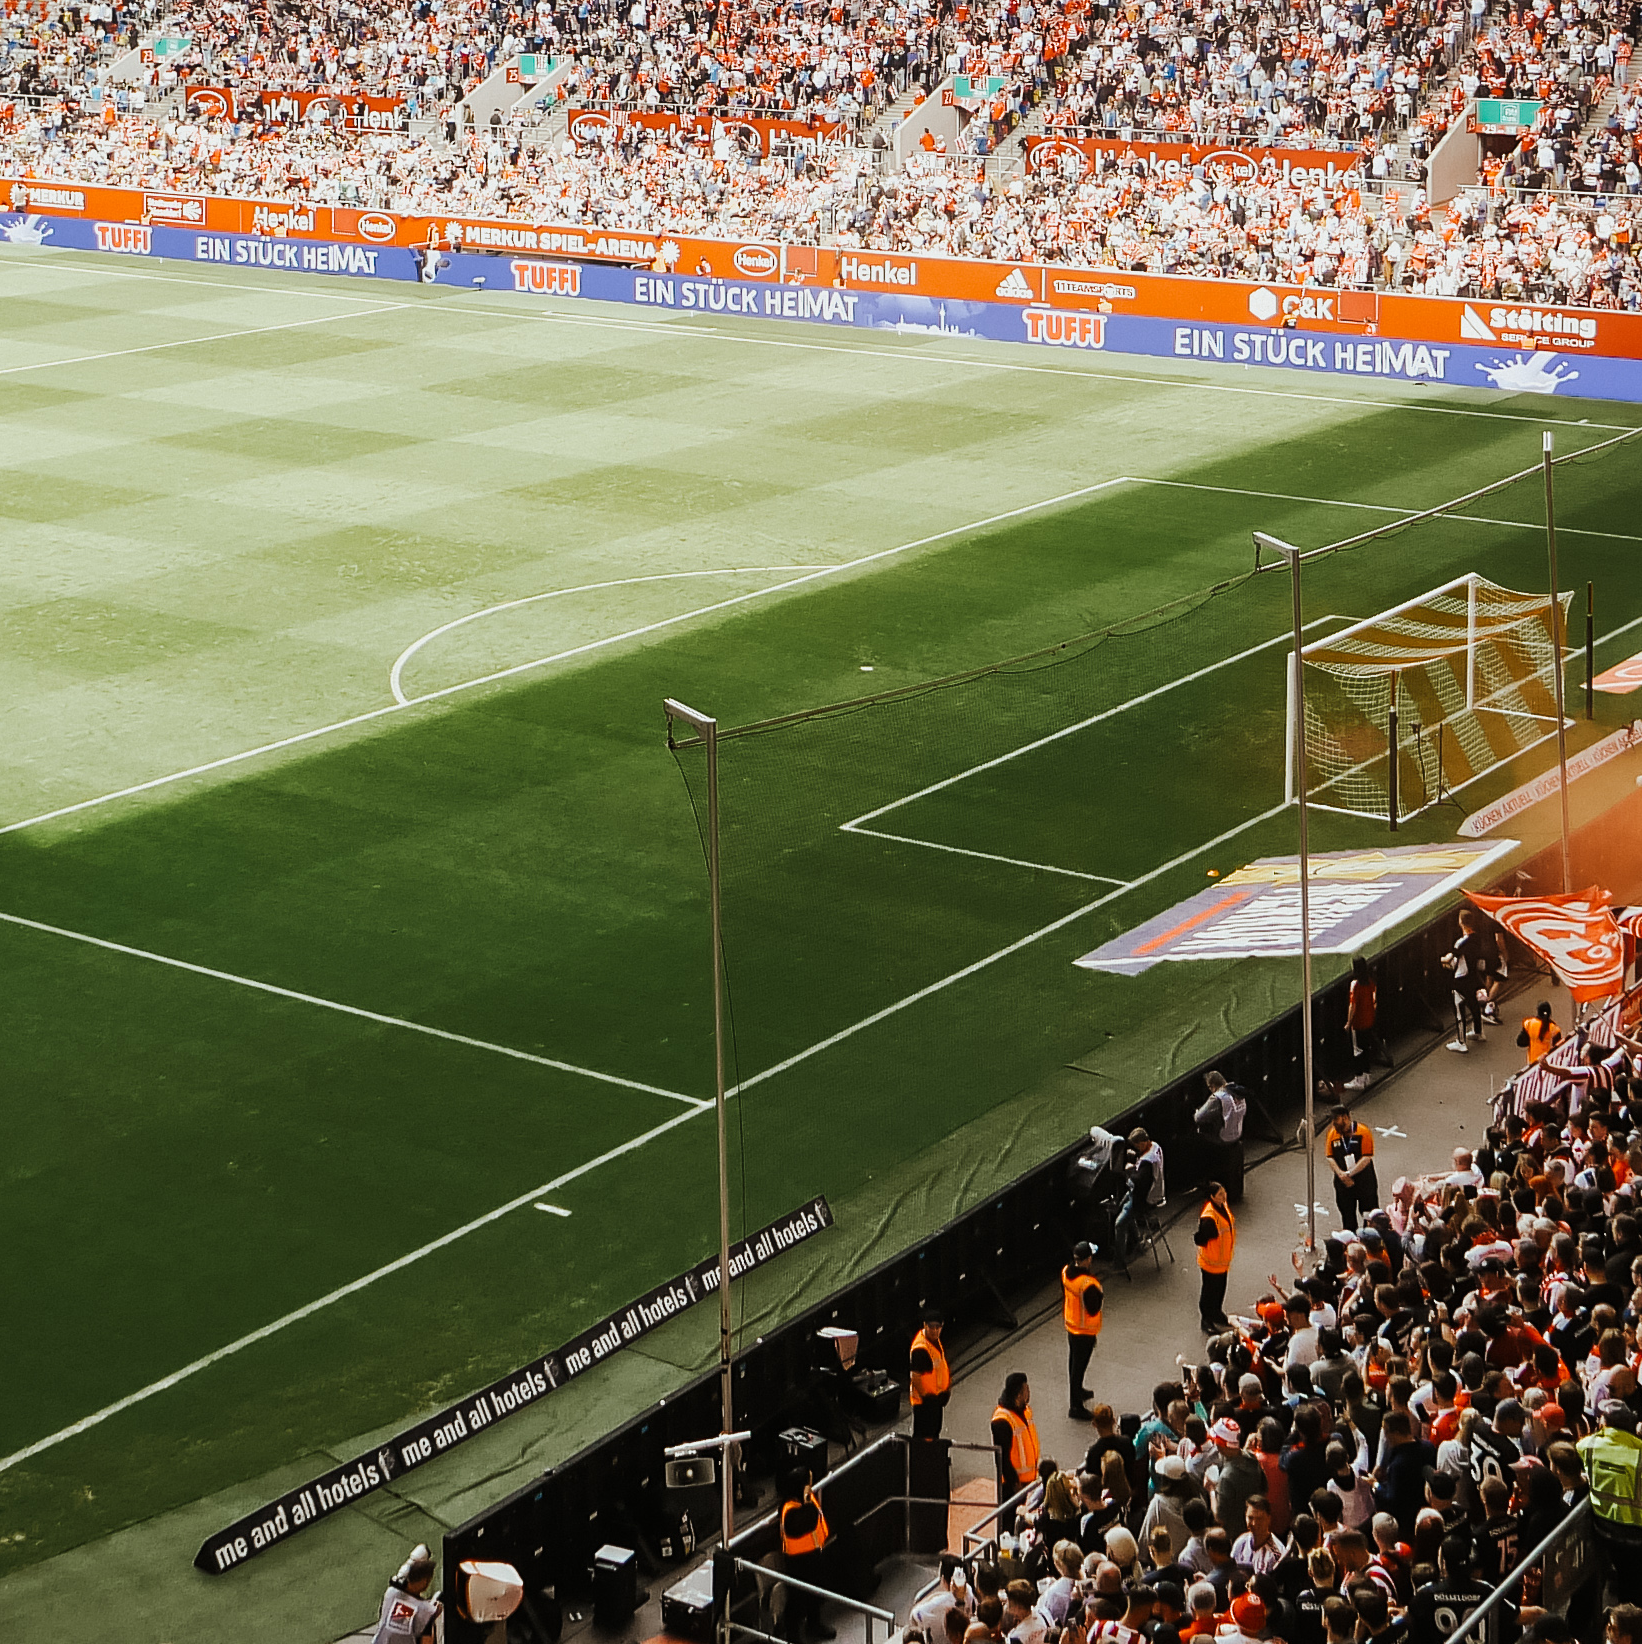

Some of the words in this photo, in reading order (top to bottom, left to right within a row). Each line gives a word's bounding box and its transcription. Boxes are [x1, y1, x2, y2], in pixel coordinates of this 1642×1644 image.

[29, 188, 86, 208] MERKUR
[253, 205, 315, 231] Henkel
[362, 219, 394, 234] Henkel
[94, 223, 153, 255] TUFFI
[196, 236, 232, 261] EIN
[235, 235, 298, 267] STÜCK
[301, 244, 379, 274] HEIMAT
[465, 225, 538, 249] MERKUR
[539, 232, 656, 260] SPIEL-ARENA
[736, 251, 776, 269] Henkel
[839, 257, 917, 286] Henkel
[511, 260, 583, 297] TUFFI
[995, 283, 1034, 300] adidas
[634, 276, 676, 306] EIN
[681, 278, 758, 314] STÜCK
[764, 289, 859, 323] HEIMAT
[1282, 294, 1334, 321] C&K
[1021, 308, 1108, 350] TUFFI
[1489, 306, 1598, 339] Stölting
[1174, 326, 1225, 359] EIN
[1233, 327, 1326, 369] STÜCK
[1335, 340, 1452, 380] HEIMAT
[1551, 336, 1596, 349] GROUP
[215, 1533, 248, 1570] me
[251, 1504, 289, 1550] and
[291, 1491, 317, 1527] all
[319, 1461, 380, 1513] hotels
[401, 1435, 432, 1468] me
[433, 1411, 468, 1450] and
[468, 1397, 492, 1431] all
[491, 1370, 547, 1417] hotels
[565, 1347, 592, 1375] me
[591, 1321, 622, 1359] and
[620, 1308, 642, 1340] all
[638, 1285, 688, 1329] hotels
[727, 1242, 756, 1277] and
[755, 1231, 774, 1261] all
[772, 1211, 818, 1249] hotels
